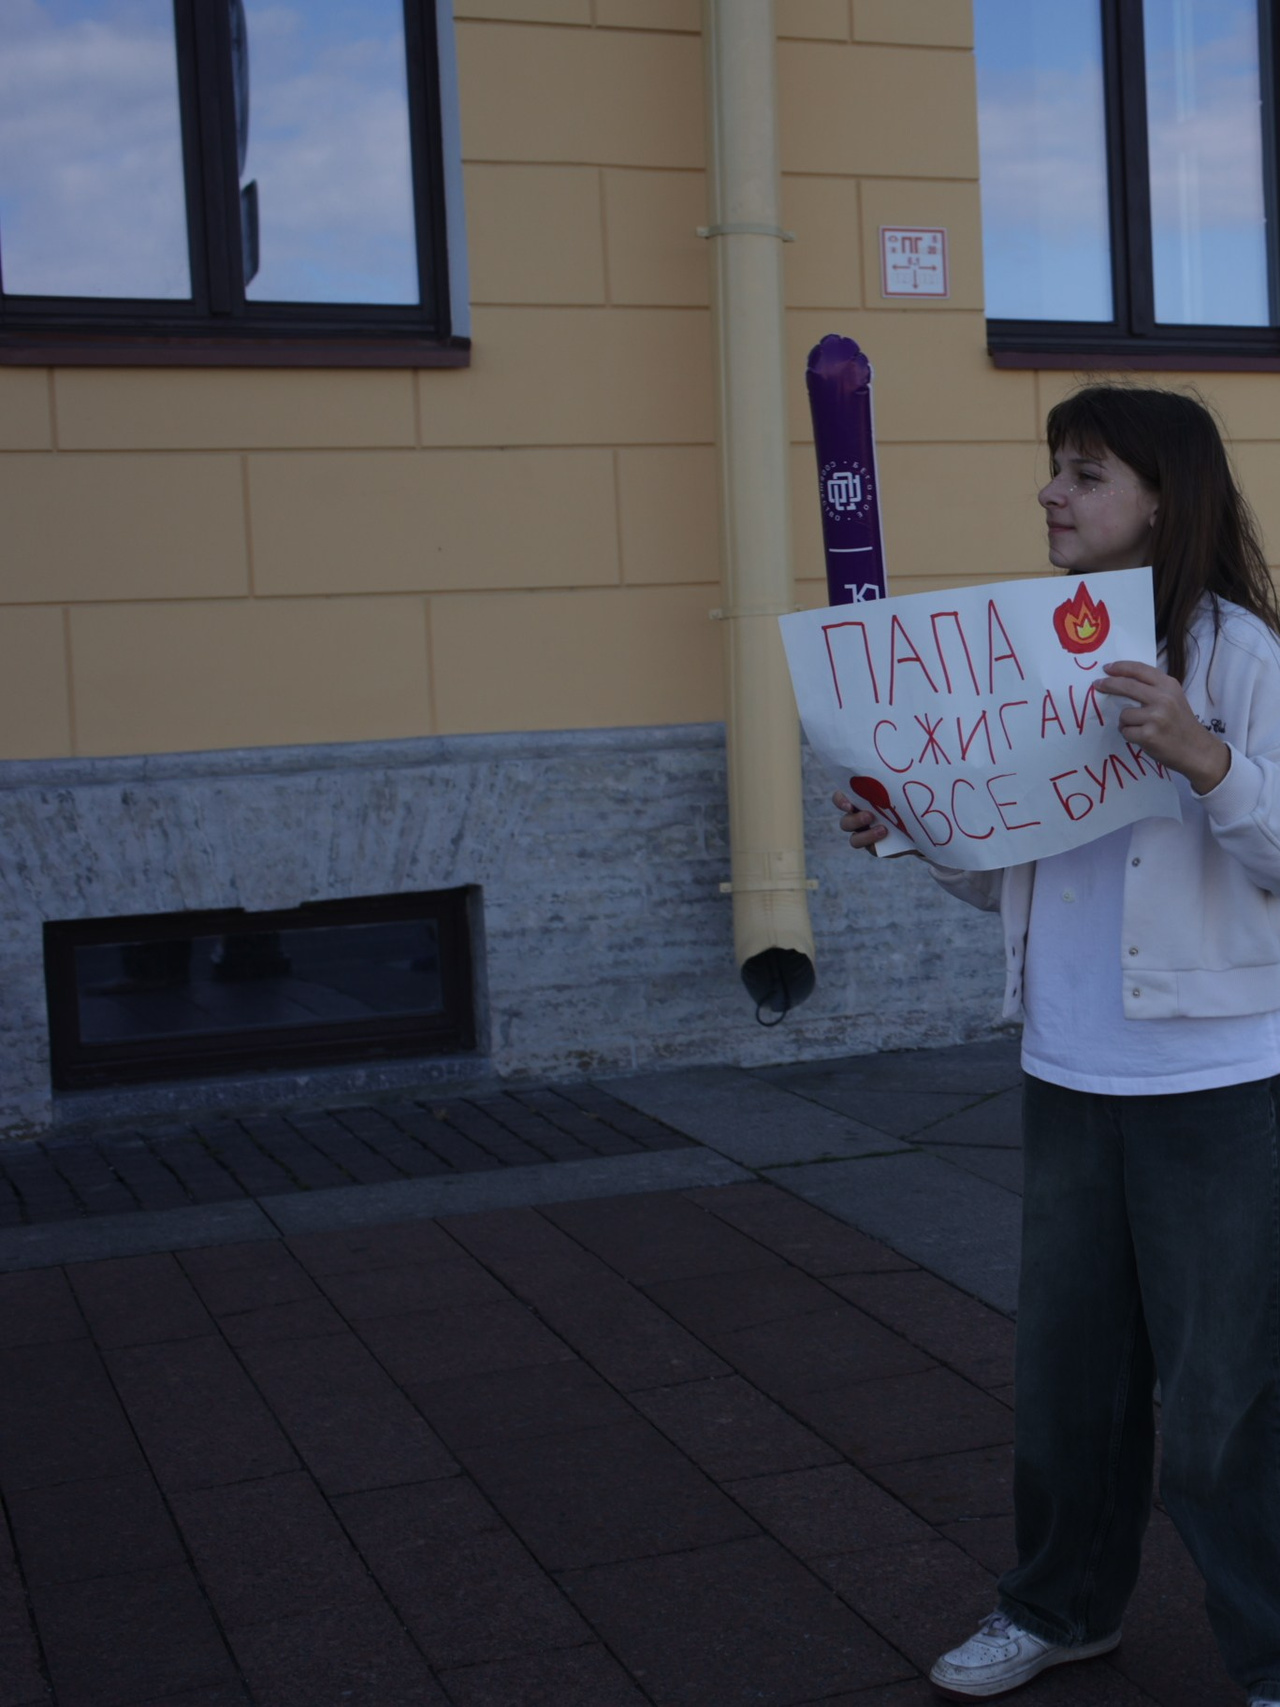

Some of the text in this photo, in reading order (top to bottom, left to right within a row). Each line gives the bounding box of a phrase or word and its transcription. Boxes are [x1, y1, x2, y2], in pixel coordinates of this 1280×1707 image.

[901, 236, 923, 254] ПГ
[821, 598, 1025, 709] ПАПА
[873, 656, 1104, 773] СЖИГАЙ
[902, 773, 1041, 847] ВСЕ
